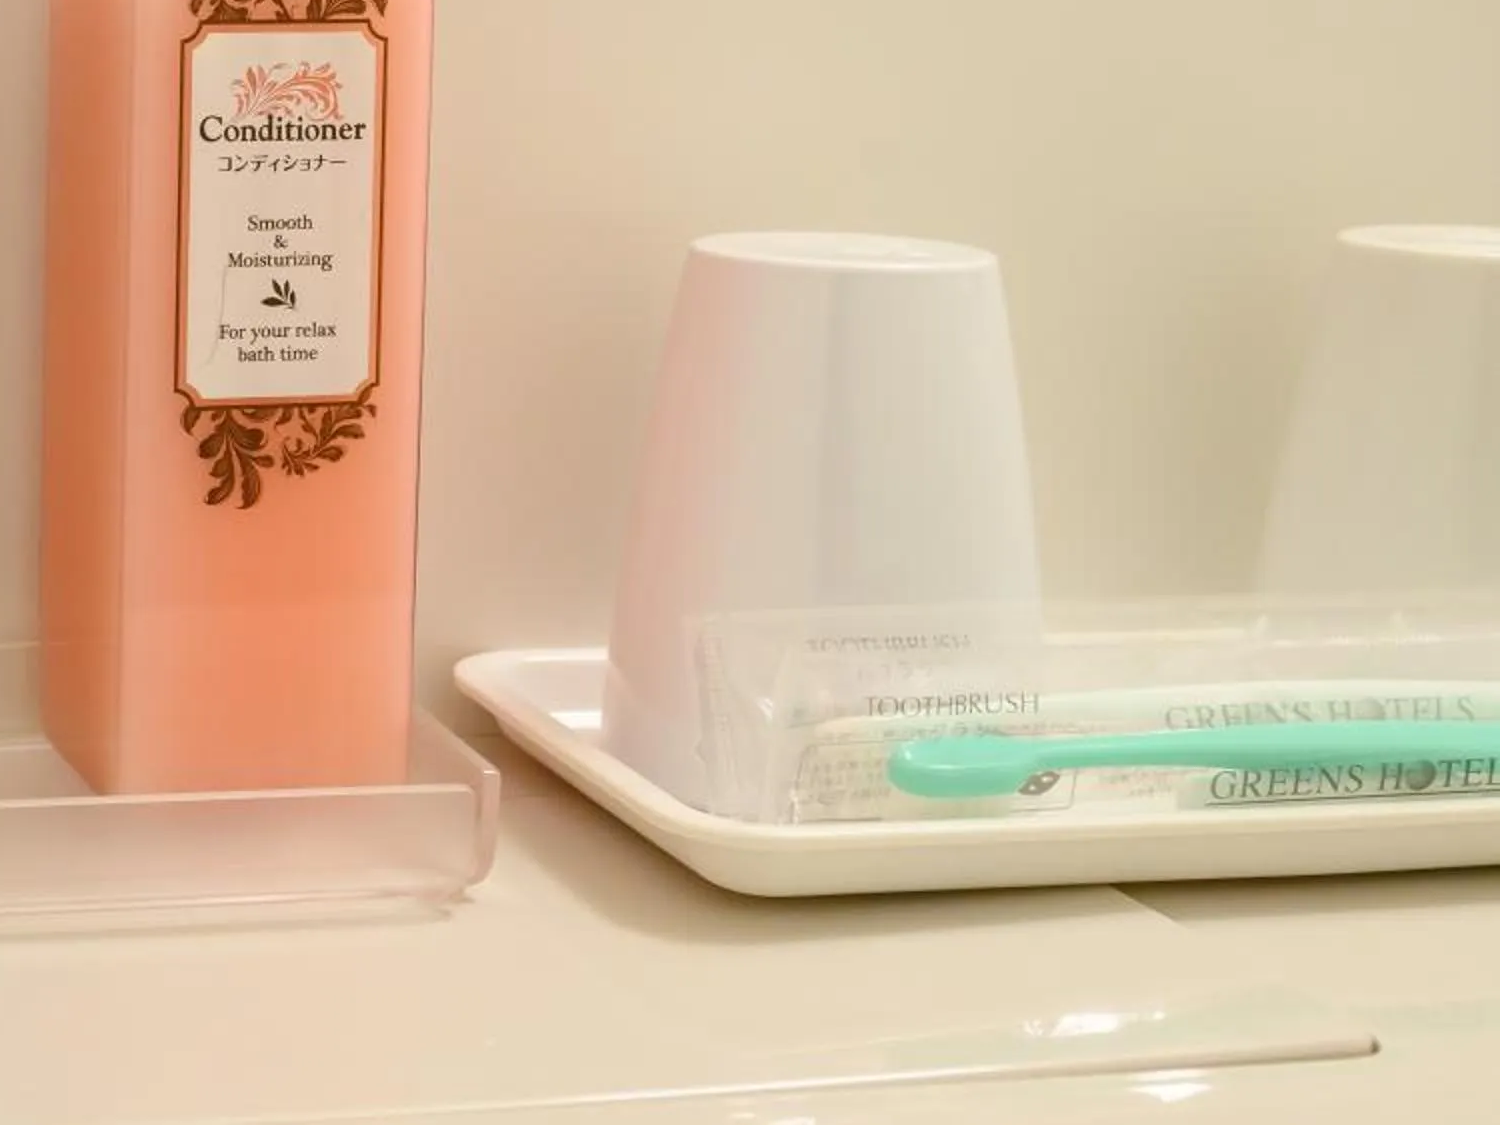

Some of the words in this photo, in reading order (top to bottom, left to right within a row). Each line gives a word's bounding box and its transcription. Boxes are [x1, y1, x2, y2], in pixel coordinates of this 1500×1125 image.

[199, 115, 366, 143] Conditioner
[218, 154, 347, 173] コンディショナー
[247, 215, 313, 231] Smooth
[273, 235, 288, 249] &
[228, 251, 333, 271] Moisturizing
[219, 324, 246, 341] For
[249, 325, 290, 346] your
[295, 321, 337, 339] relax
[238, 346, 275, 363] bath
[280, 346, 319, 362] time
[866, 692, 1040, 717] TOOTHBRUSH
[1210, 763, 1365, 800] GREENS
